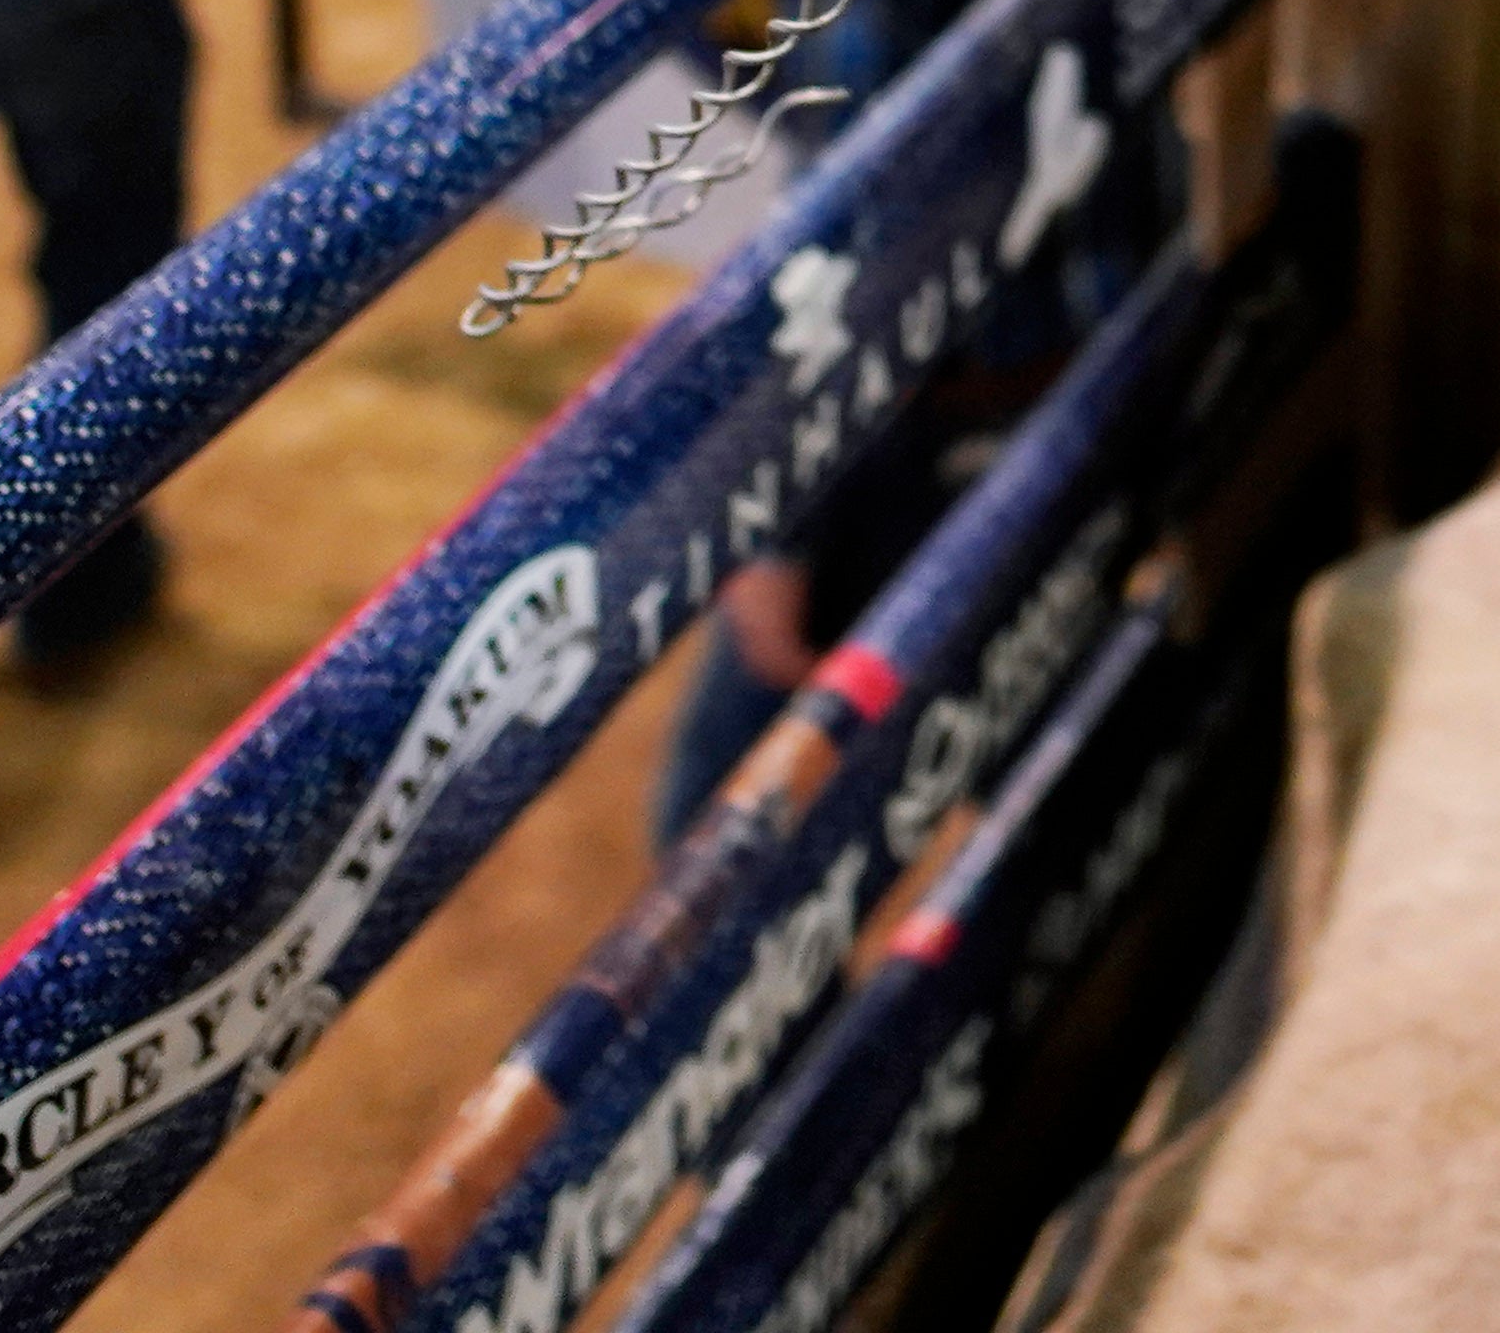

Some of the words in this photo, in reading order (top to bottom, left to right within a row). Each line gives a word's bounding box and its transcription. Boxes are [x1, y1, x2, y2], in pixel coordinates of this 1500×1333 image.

[188, 986, 238, 1070] Y
[253, 925, 315, 1011] OF
[336, 569, 574, 889] YOAKUM
